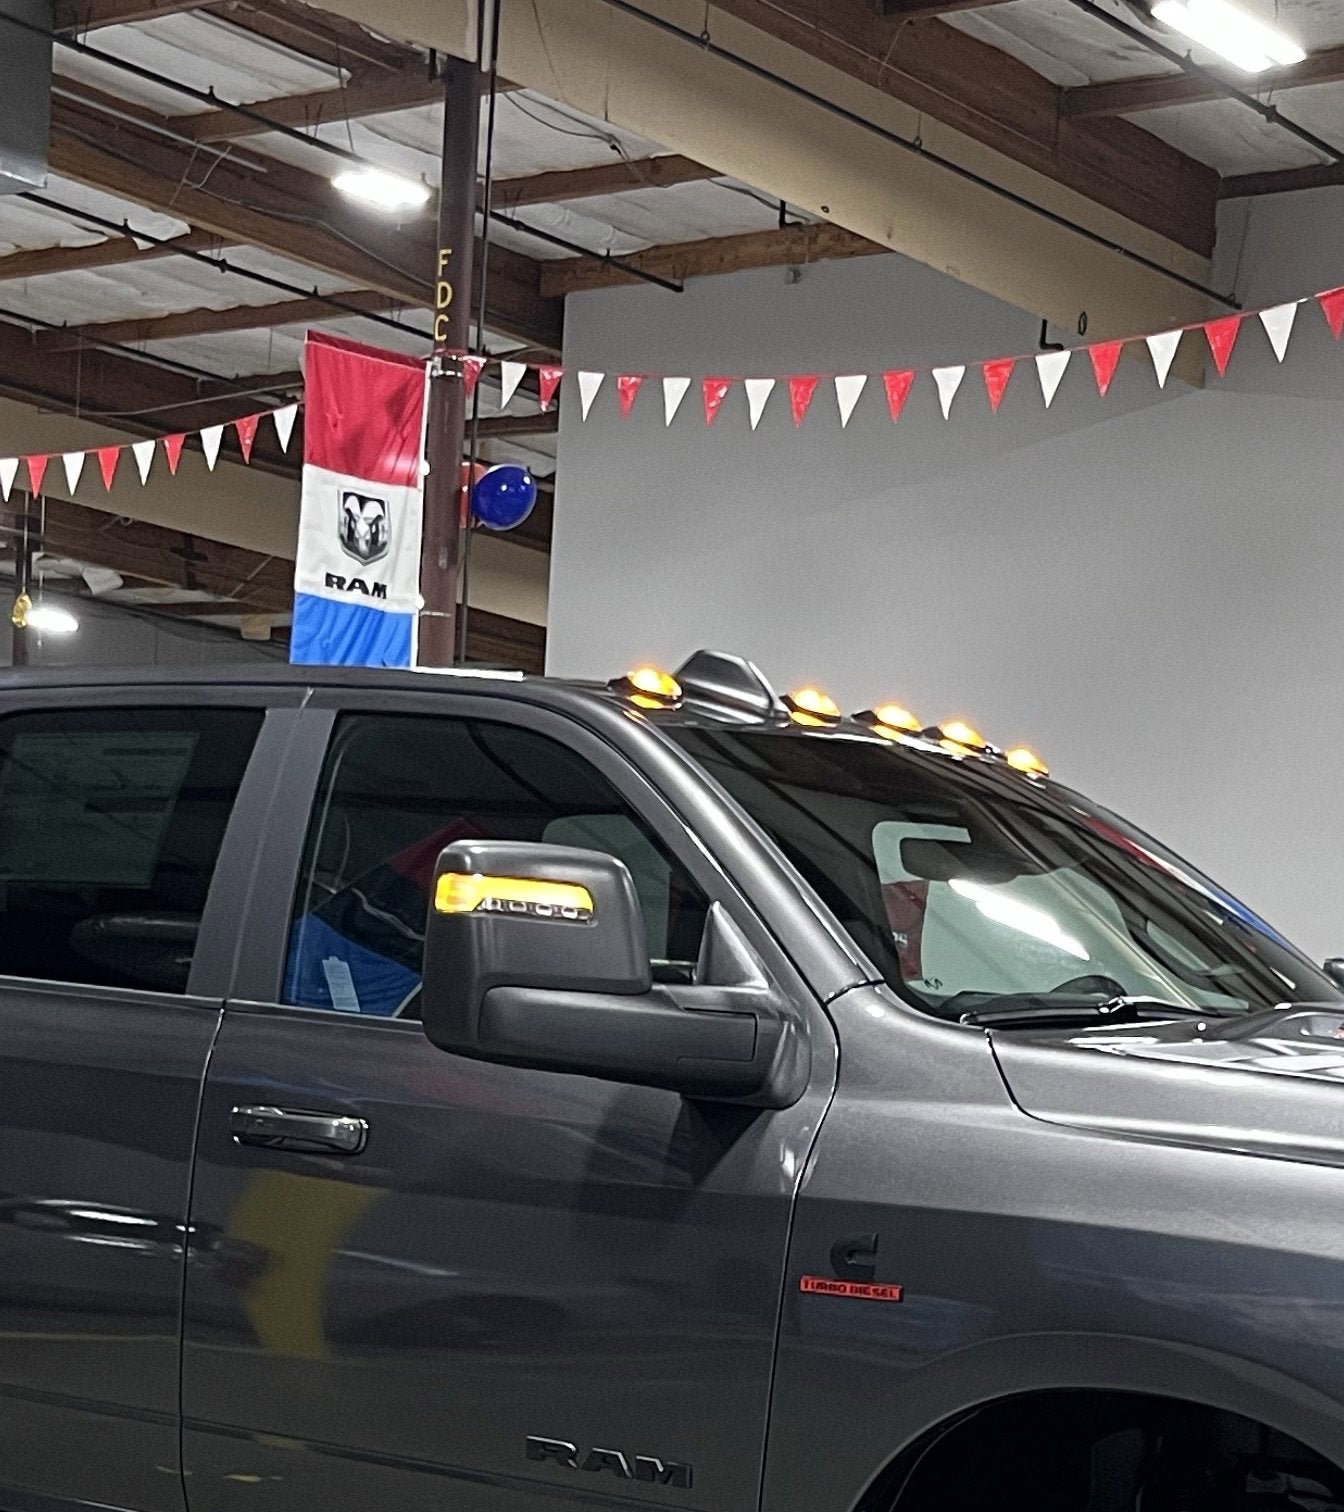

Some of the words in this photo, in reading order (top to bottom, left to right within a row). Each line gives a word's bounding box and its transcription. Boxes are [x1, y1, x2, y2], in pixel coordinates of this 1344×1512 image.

[435, 249, 453, 341] FDC
[324, 572, 388, 599] RAM
[803, 1279, 847, 1293] TURBO
[849, 1284, 896, 1298] DIESEL
[525, 1434, 693, 1489] RAM
